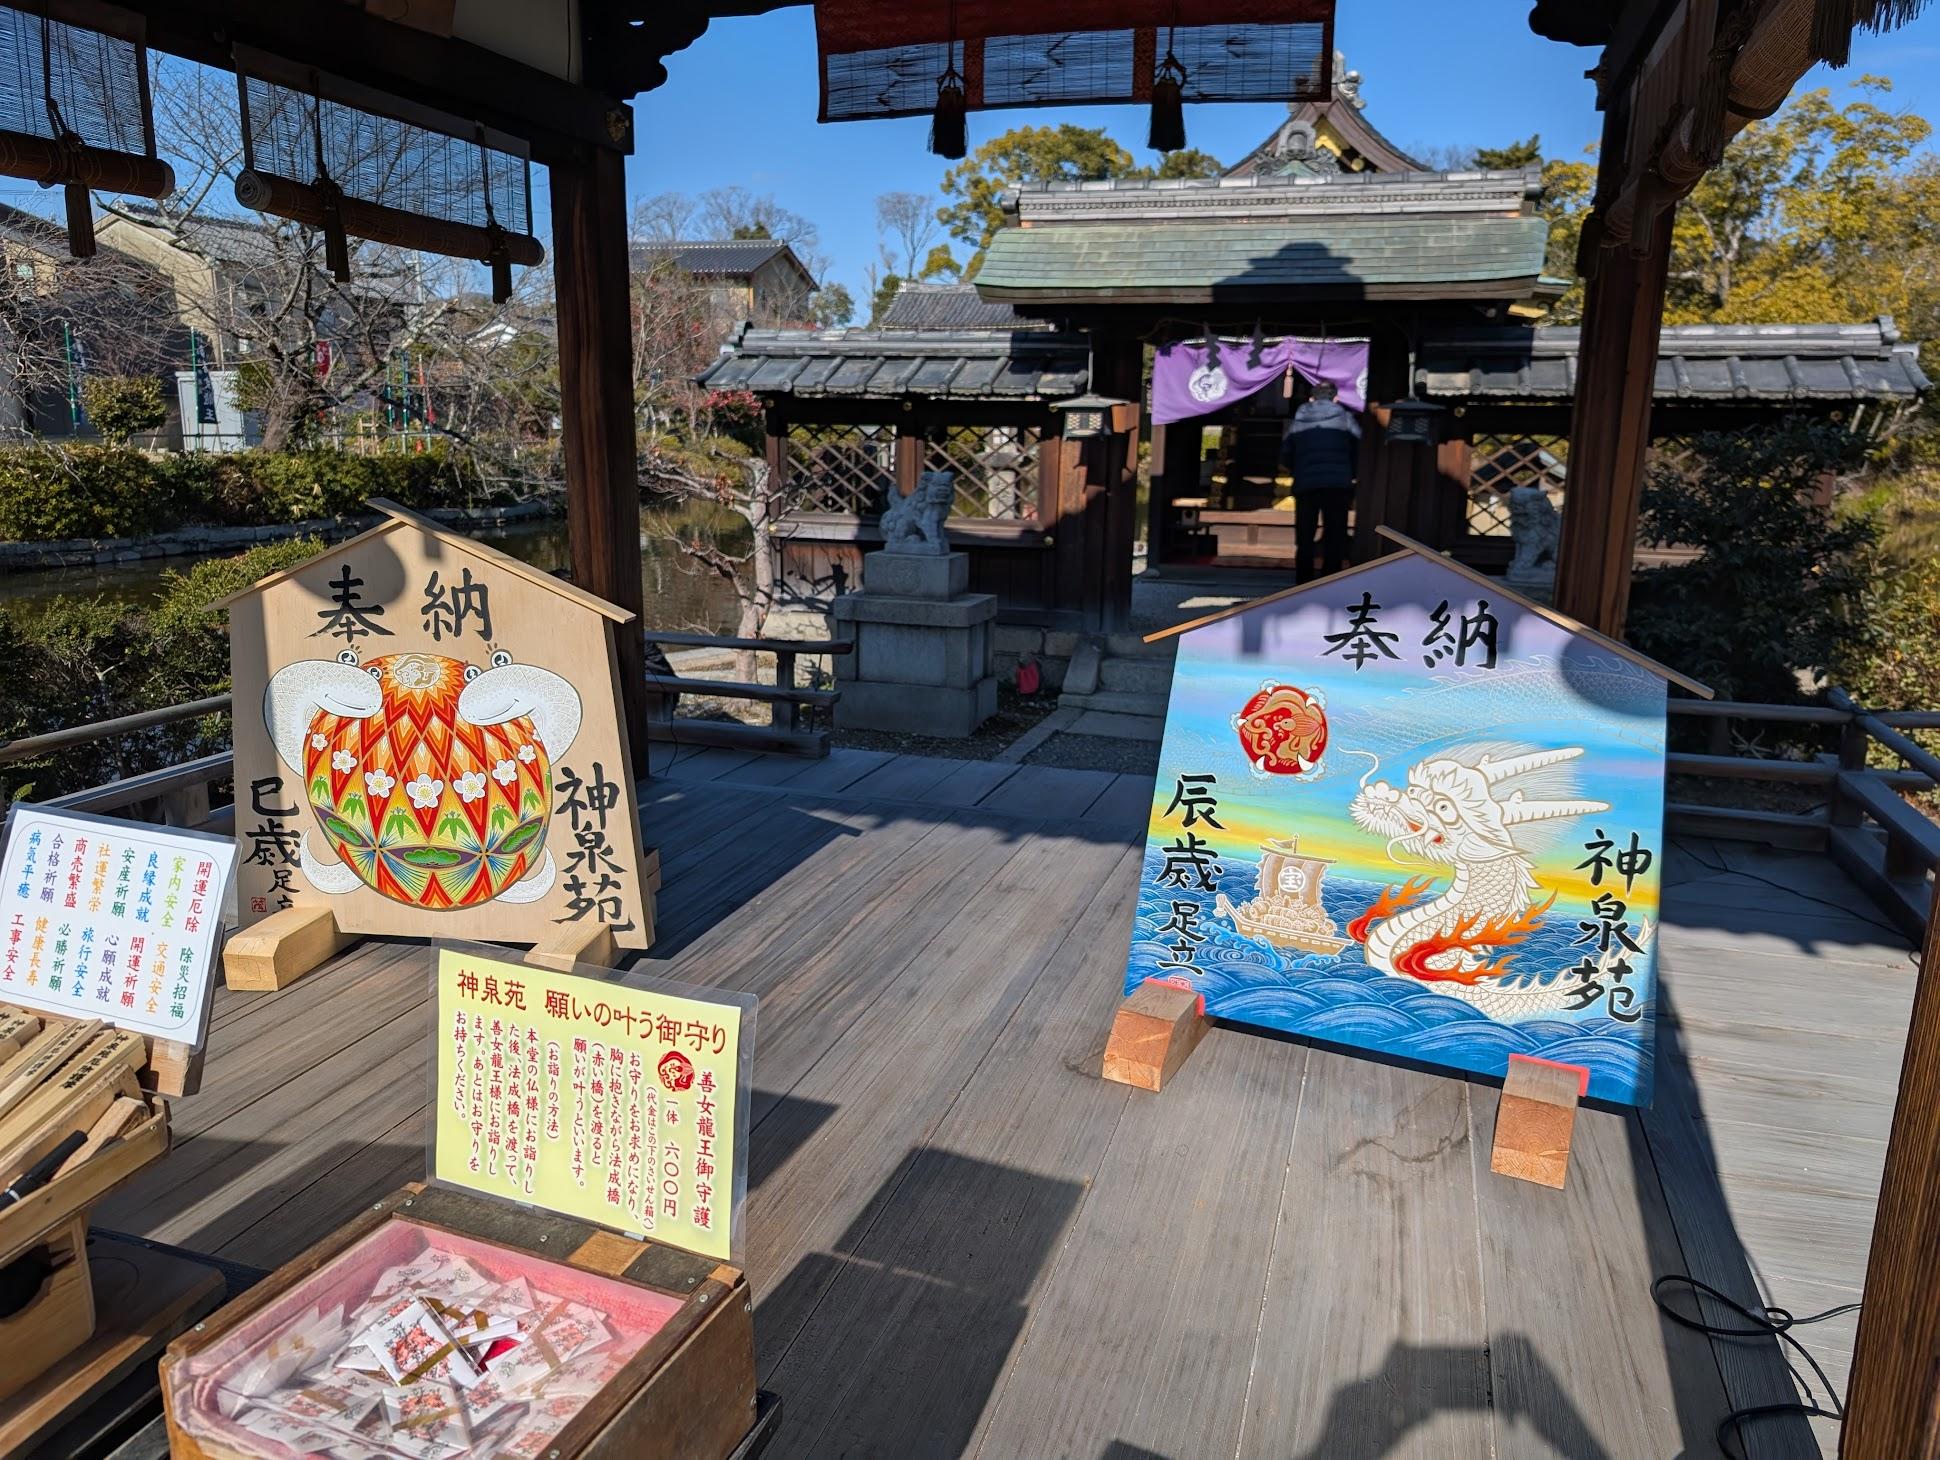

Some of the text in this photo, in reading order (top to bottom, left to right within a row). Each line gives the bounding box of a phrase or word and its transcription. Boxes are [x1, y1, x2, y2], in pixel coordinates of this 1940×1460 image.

[305, 564, 494, 643] 奉納
[1320, 591, 1500, 672] 奉納
[3, 830, 41, 981] 病気平癒 工事安全
[27, 833, 64, 986] 合格祈願 健康長寿
[49, 837, 88, 992] 商売繁盛 必勝祈願
[72, 843, 111, 997] 社運繁栄 旅行安全
[96, 847, 136, 1002] 安産祈願 心願成就
[551, 762, 636, 932] 神泉苑
[1281, 869, 1303, 892] 宝
[120, 851, 158, 1008] 良縁成就 開運祈願
[146, 856, 186, 1013] 家内安全 交通安全
[170, 861, 212, 1019] 開運厄除 除災招福
[1560, 828, 1652, 1025] 神泉苑
[454, 1011, 468, 1119] お持ちください。
[457, 969, 726, 1054] 神泉苑 願いの叶う御守り
[470, 1016, 486, 1171] ます。あとはお守りを
[488, 1020, 503, 1175] 善女龍王様にお詣りし
[524, 1028, 539, 1194] 本堂の仏様にお詣りし
[572, 1038, 587, 1187] 願いが叶うといいます。
[607, 1048, 624, 1205] 胸に抱きながら法成橋
[665, 1100, 679, 1125] 一体
[693, 1072, 716, 1229] 善女龍王御守護
